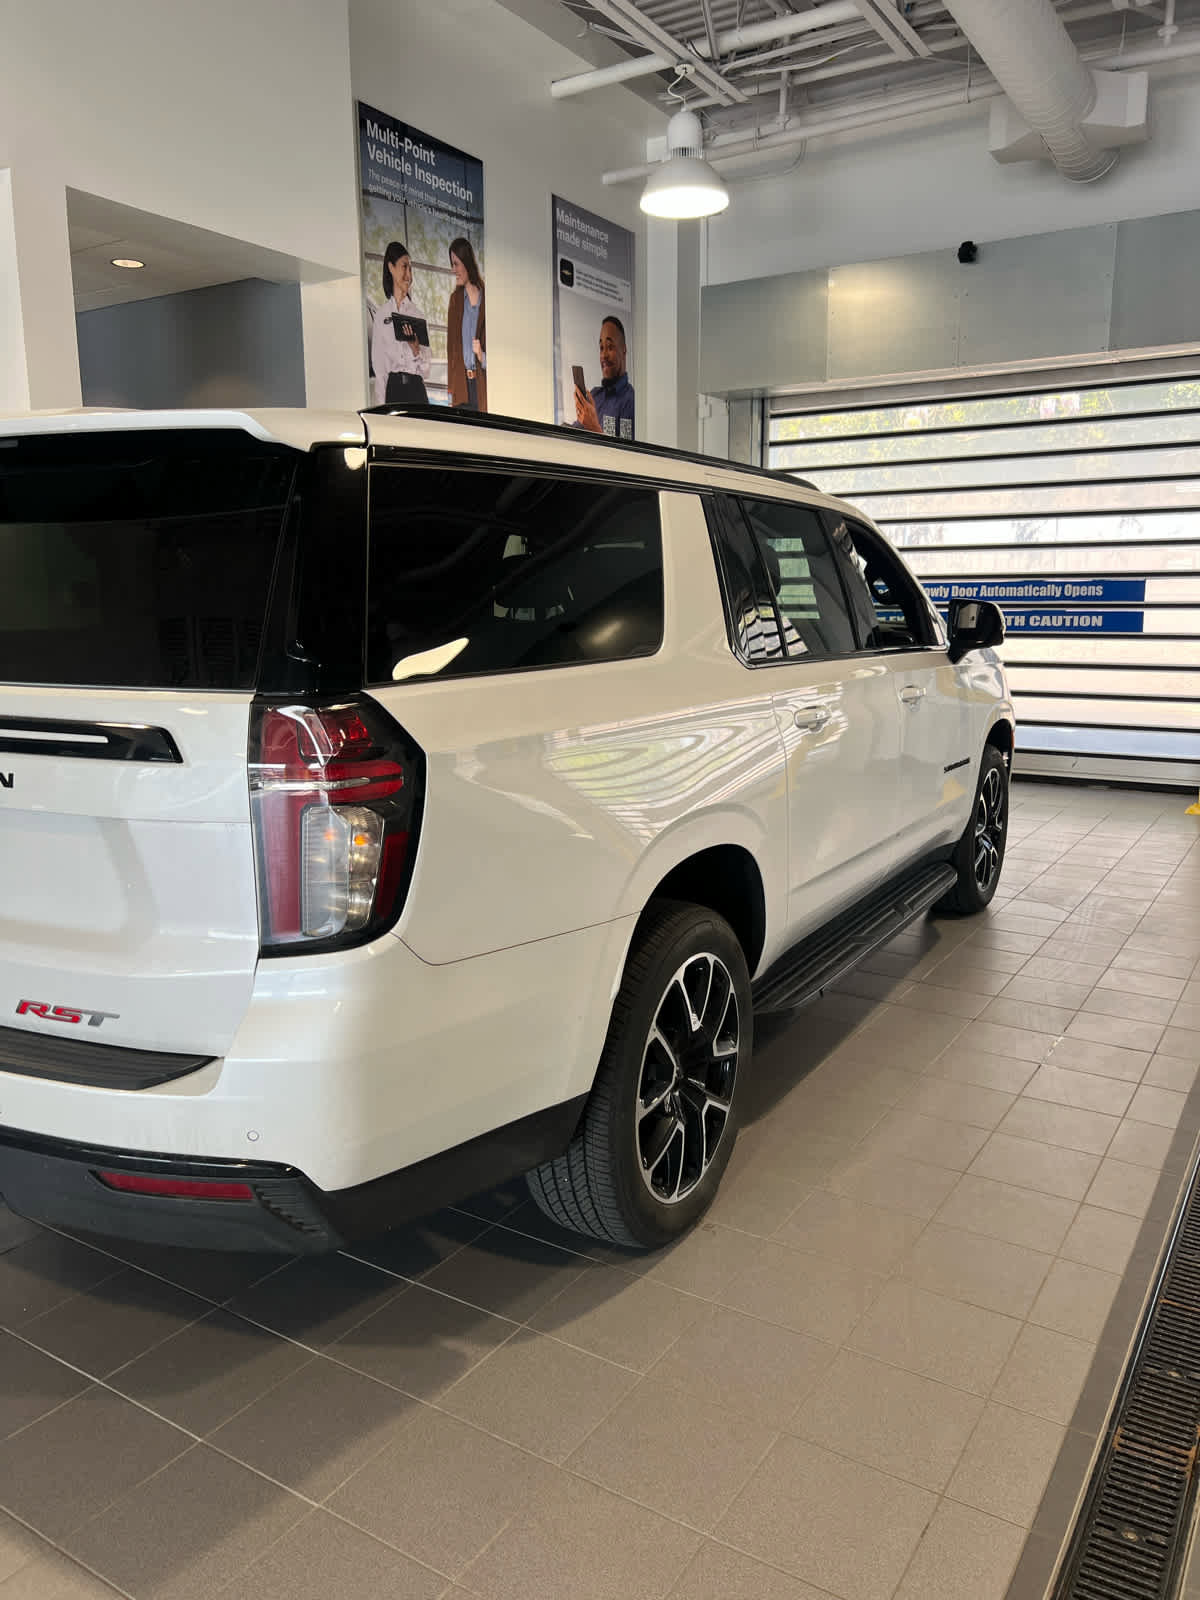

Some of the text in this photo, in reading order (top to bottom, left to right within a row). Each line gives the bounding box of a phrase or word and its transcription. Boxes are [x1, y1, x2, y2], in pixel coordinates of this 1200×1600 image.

[366, 119, 435, 166] Multi-Point
[367, 142, 472, 202] Vehicle Inspection
[556, 208, 608, 244] Maintenance
[556, 228, 608, 259] made simple
[952, 585, 978, 597] Door
[980, 584, 1062, 598] Automatically
[1064, 584, 1103, 597] Opens
[1029, 615, 1103, 627] CAUTION
[16, 999, 120, 1027] RST
